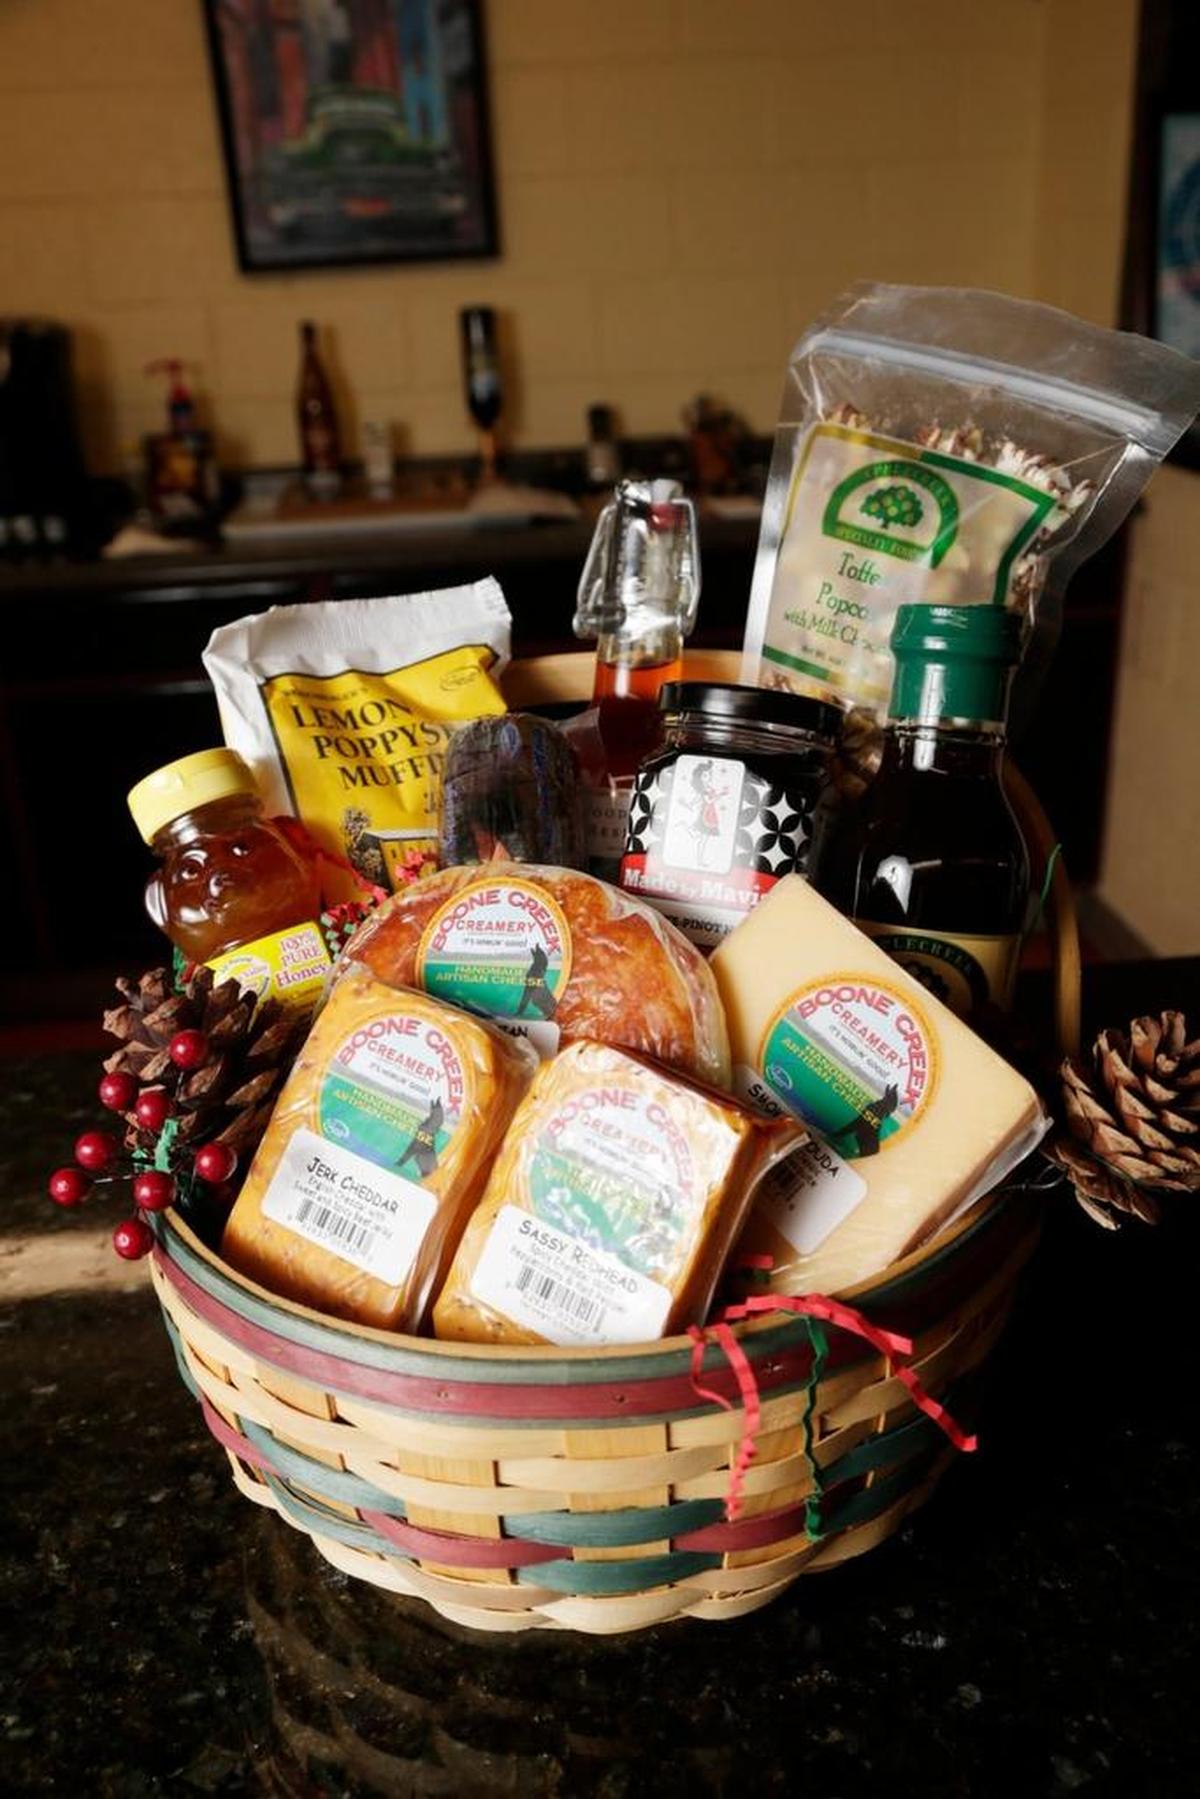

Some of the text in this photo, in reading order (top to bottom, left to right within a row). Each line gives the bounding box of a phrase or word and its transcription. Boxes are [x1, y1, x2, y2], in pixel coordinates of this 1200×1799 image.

[815, 582, 870, 619] Popco
[808, 613, 839, 638] Milk
[291, 698, 413, 731] LEMON
[431, 889, 562, 955] BOONE CREEK
[455, 919, 537, 934] CREAMERY
[682, 917, 722, 934] PINOT
[275, 963, 327, 987] Honey
[281, 945, 320, 967] PURE
[435, 972, 545, 988] ARTISAN CHEESE
[797, 986, 928, 1111] BOONE CREEK
[831, 1002, 908, 1069] CREAMERY
[337, 1018, 464, 1118] BOONE CREEK
[366, 1040, 446, 1083] CREAMERY
[782, 1037, 835, 1083] ARTISAN
[832, 1082, 882, 1129] CHEESE
[806, 1042, 877, 1103] HANDMADE
[548, 1088, 640, 1136] BOONE
[748, 1083, 783, 1118] SMO
[306, 1156, 399, 1215] JERK CHEDDAR
[518, 1219, 638, 1294] SASSY REDHEAD
